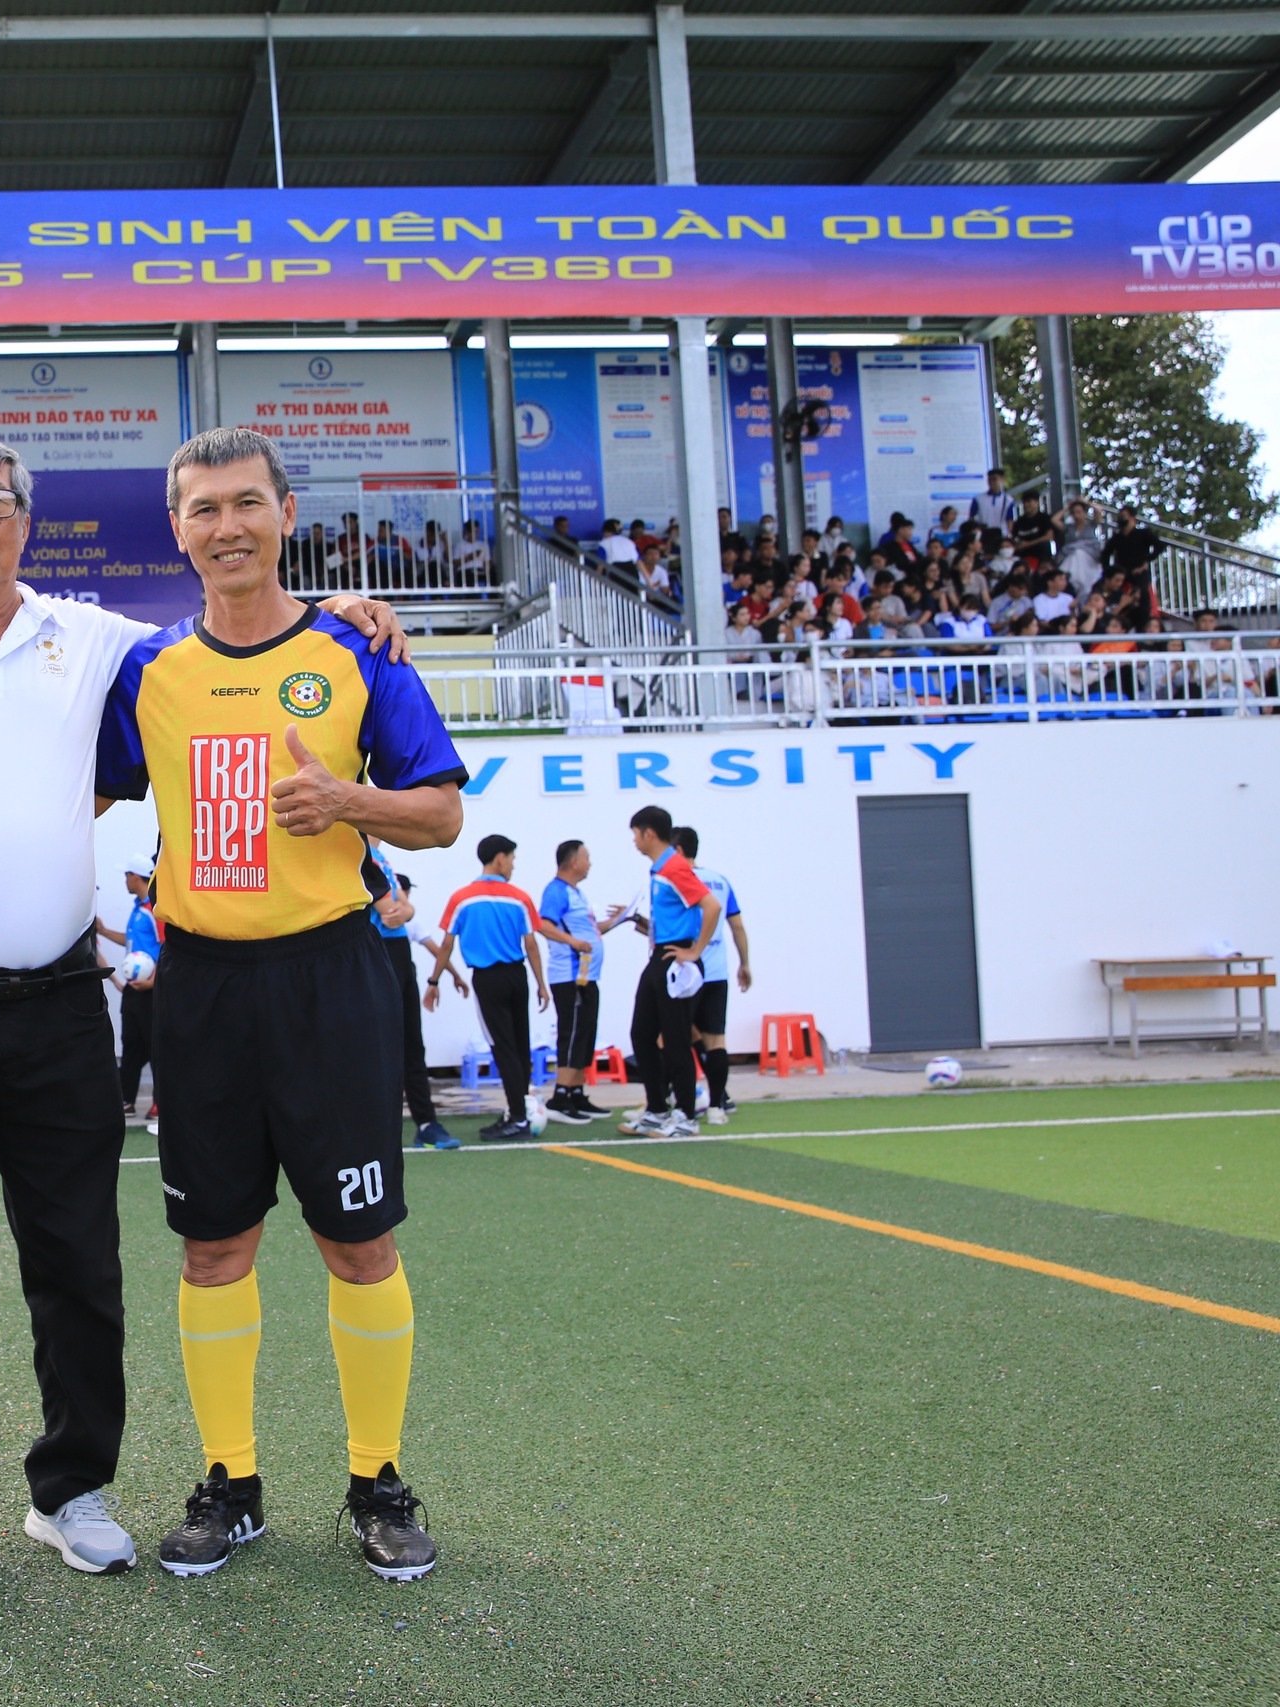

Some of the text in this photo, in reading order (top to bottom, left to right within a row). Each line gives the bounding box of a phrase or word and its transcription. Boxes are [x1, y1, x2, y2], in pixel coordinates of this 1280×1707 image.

[29, 219, 251, 246] SINH
[288, 212, 502, 242] VIÊN
[537, 209, 785, 240] TOÀN
[823, 205, 1074, 243] QUỐC
[1158, 211, 1252, 248] CÚP
[133, 253, 331, 284] CÚP
[365, 256, 673, 282] TV360
[1130, 242, 1280, 280] TV360
[36, 408, 68, 424] ĐÀO
[73, 409, 105, 425] TẠO
[109, 406, 132, 423] TỪ
[136, 408, 158, 422] XA
[282, 403, 308, 416] THI
[313, 400, 358, 416] ĐÁNH
[362, 399, 390, 415] GIÁ
[8, 430, 143, 443] ĐÀO TẠO TRÌNH ĐỘ ĐẠI HỌC
[288, 422, 319, 440] LỰC
[323, 418, 371, 436] TIẾNG
[376, 422, 410, 435] ANH
[30, 547, 107, 561] VÒNG LOẠI
[19, 562, 52, 578] MIỀN
[56, 565, 88, 578] NAM
[101, 561, 142, 577] ĐỒNG
[146, 561, 185, 576] THÁP
[211, 687, 261, 697] KEEPFLY
[285, 702, 324, 716] ĐỒNG THÁP
[338, 1160, 384, 1212] 20
